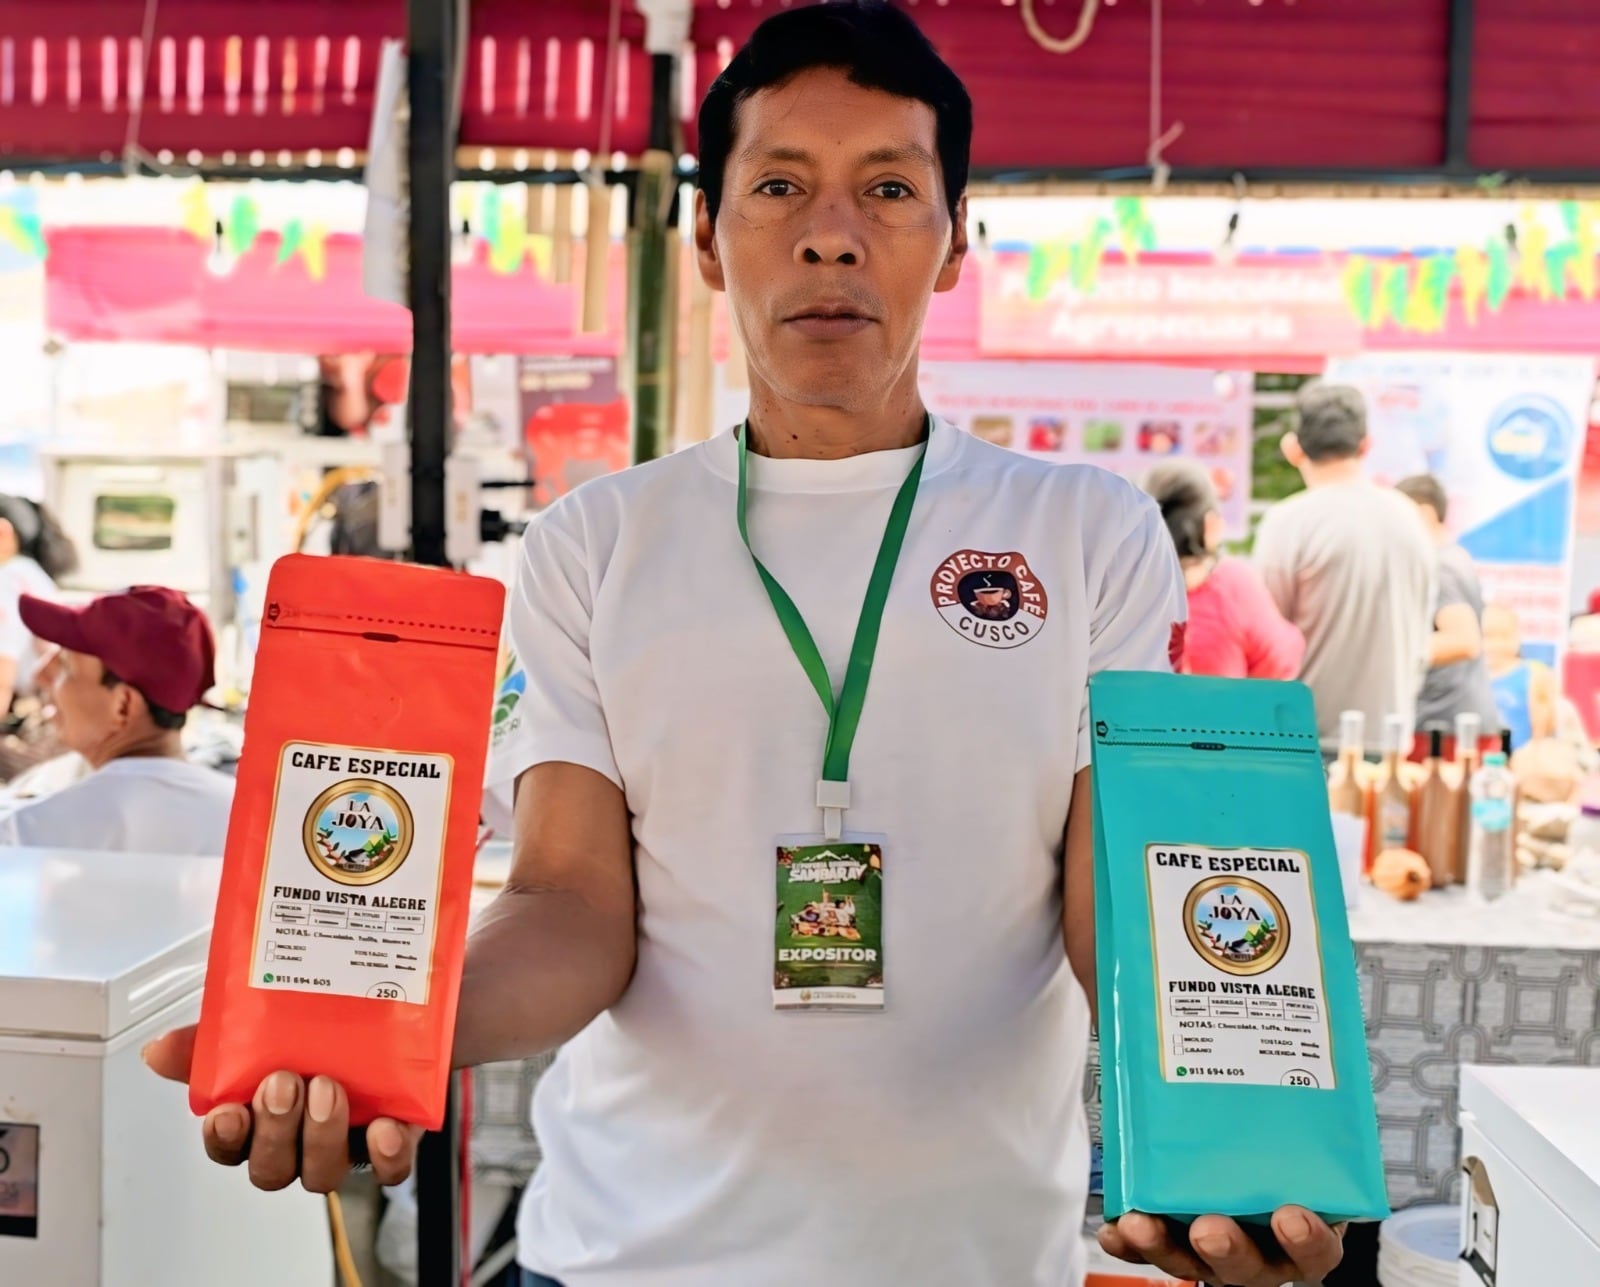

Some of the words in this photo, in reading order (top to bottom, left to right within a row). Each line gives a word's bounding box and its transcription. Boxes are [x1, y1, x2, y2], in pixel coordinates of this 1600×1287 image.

[1001, 273, 1160, 304] Pycto
[936, 554, 1011, 605] PROYECTO
[1015, 565, 1045, 616] CAFÉ
[960, 617, 1029, 642] CUSCO
[292, 752, 341, 771] CAFE
[347, 758, 440, 778] ESPECIAL
[349, 800, 370, 812] LA
[332, 813, 384, 830] JOYA
[1156, 852, 1202, 870] CAFE
[1208, 857, 1300, 873] ESPECIAL
[788, 864, 867, 883] SAMBARAY
[273, 886, 320, 901] FUNDO
[326, 892, 366, 906] VISTA
[372, 897, 427, 911] ALEGRE
[1220, 894, 1242, 905] LA
[1208, 906, 1260, 921] JOYA
[779, 948, 877, 961] EXPOSITOR
[376, 988, 398, 998] 250
[1168, 981, 1216, 993] FUNDO
[1220, 982, 1261, 995] VISTA
[1266, 984, 1316, 999] ALEGRE
[1179, 1021, 1215, 1029] NOTAS:
[1189, 1067, 1204, 1075] 913
[1207, 1068, 1224, 1076] 694
[1227, 1068, 1244, 1076] 605
[1289, 1076, 1310, 1086] 250
